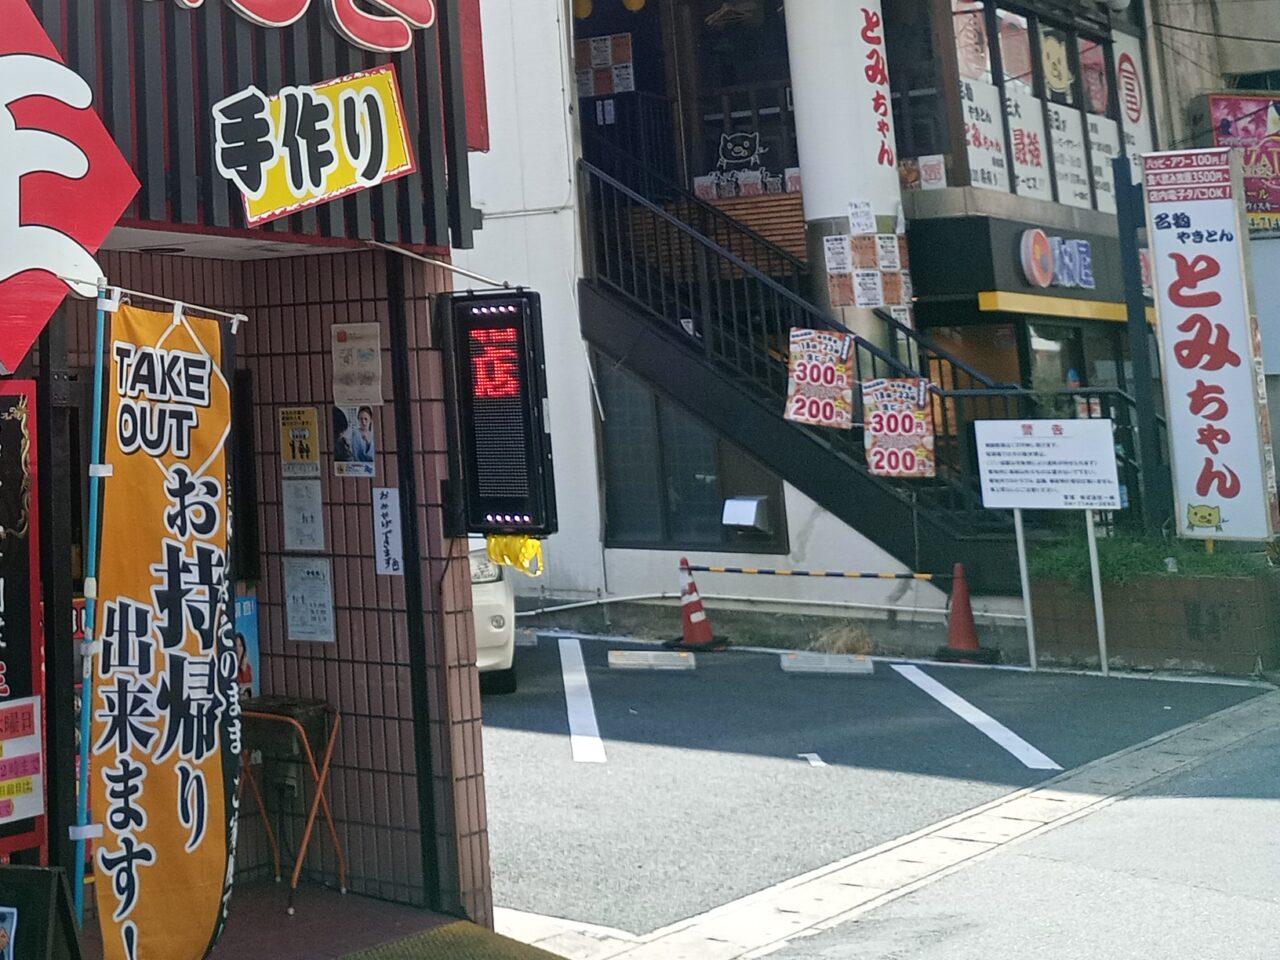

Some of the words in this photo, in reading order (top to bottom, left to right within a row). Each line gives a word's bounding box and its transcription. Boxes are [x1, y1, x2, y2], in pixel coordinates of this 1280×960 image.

[860, 8, 895, 167] とみちゃん
[213, 84, 389, 199] 手作り
[1154, 212, 1191, 230] 名物
[1177, 229, 1234, 244] やきとん
[114, 341, 211, 399] TAKE
[1167, 252, 1241, 499] とみちゃん
[118, 404, 199, 457] OUT
[151, 466, 227, 852] お持帰り
